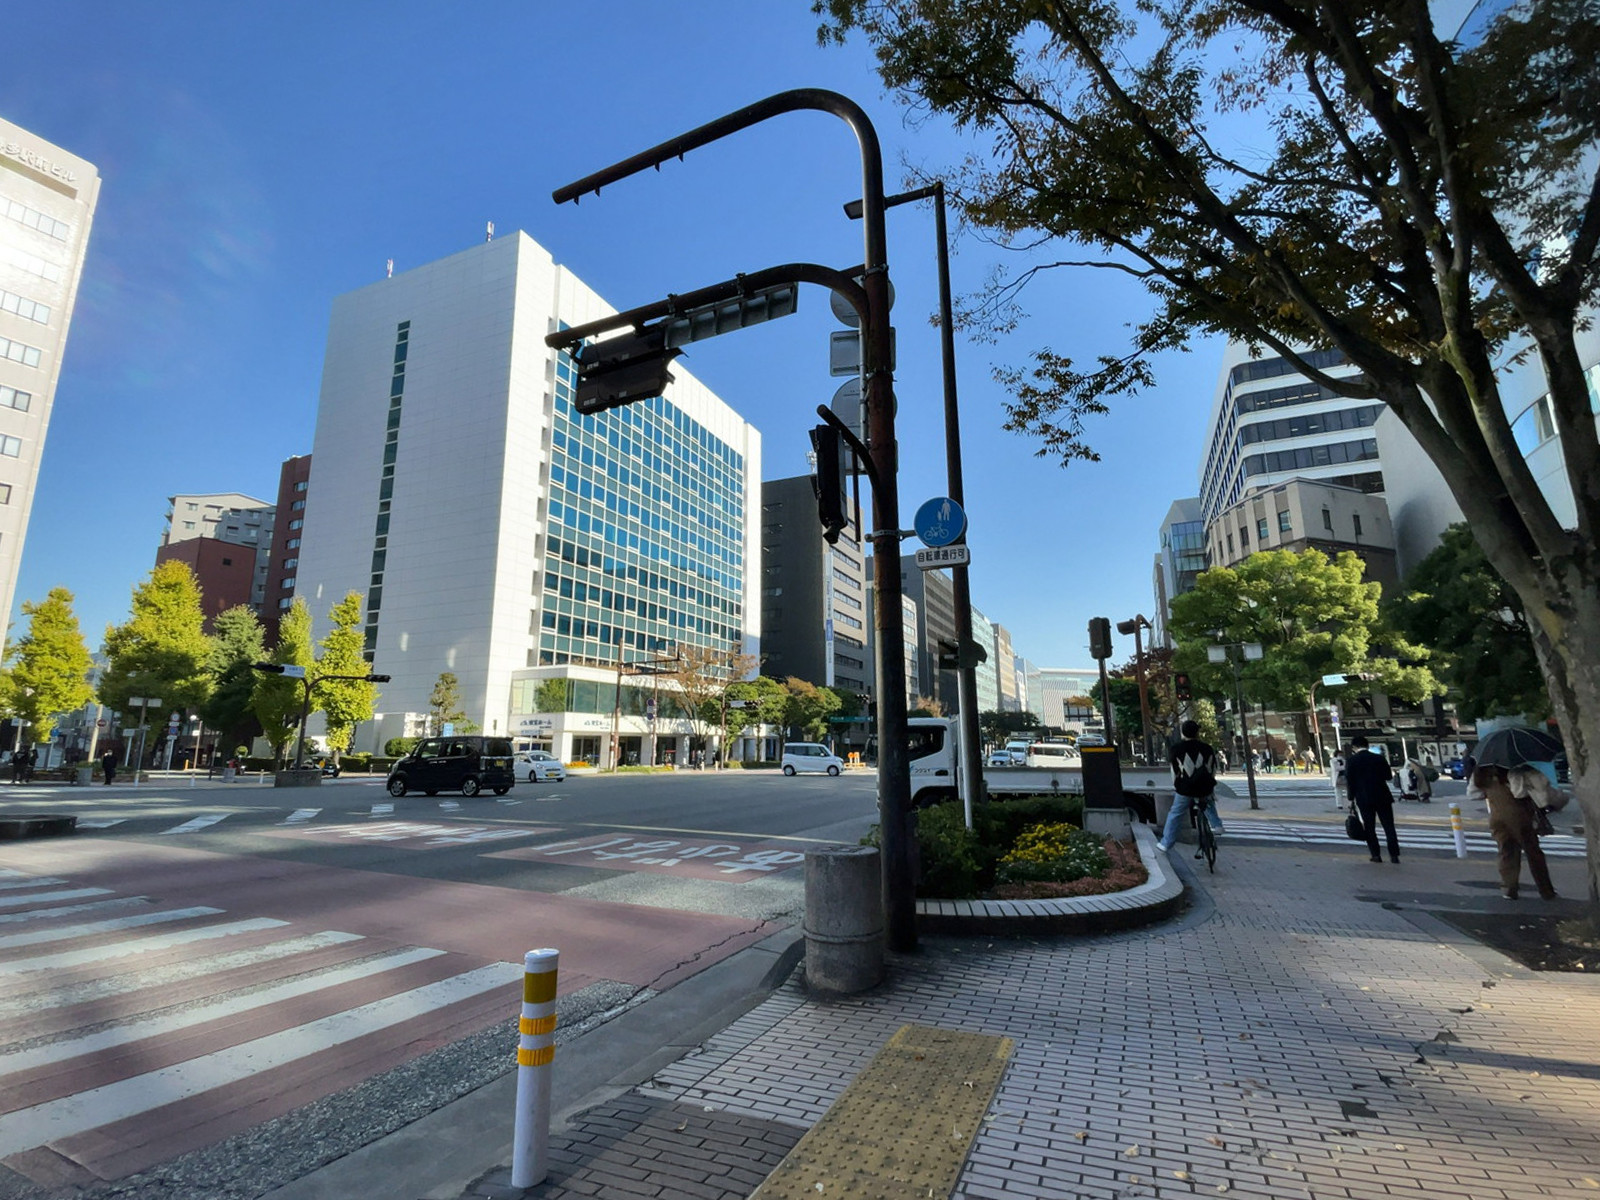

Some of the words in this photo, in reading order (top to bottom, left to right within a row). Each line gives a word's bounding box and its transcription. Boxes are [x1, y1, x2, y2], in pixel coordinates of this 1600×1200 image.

[917, 548, 966, 563] 自転車通行可
[531, 837, 806, 875] あぶない
